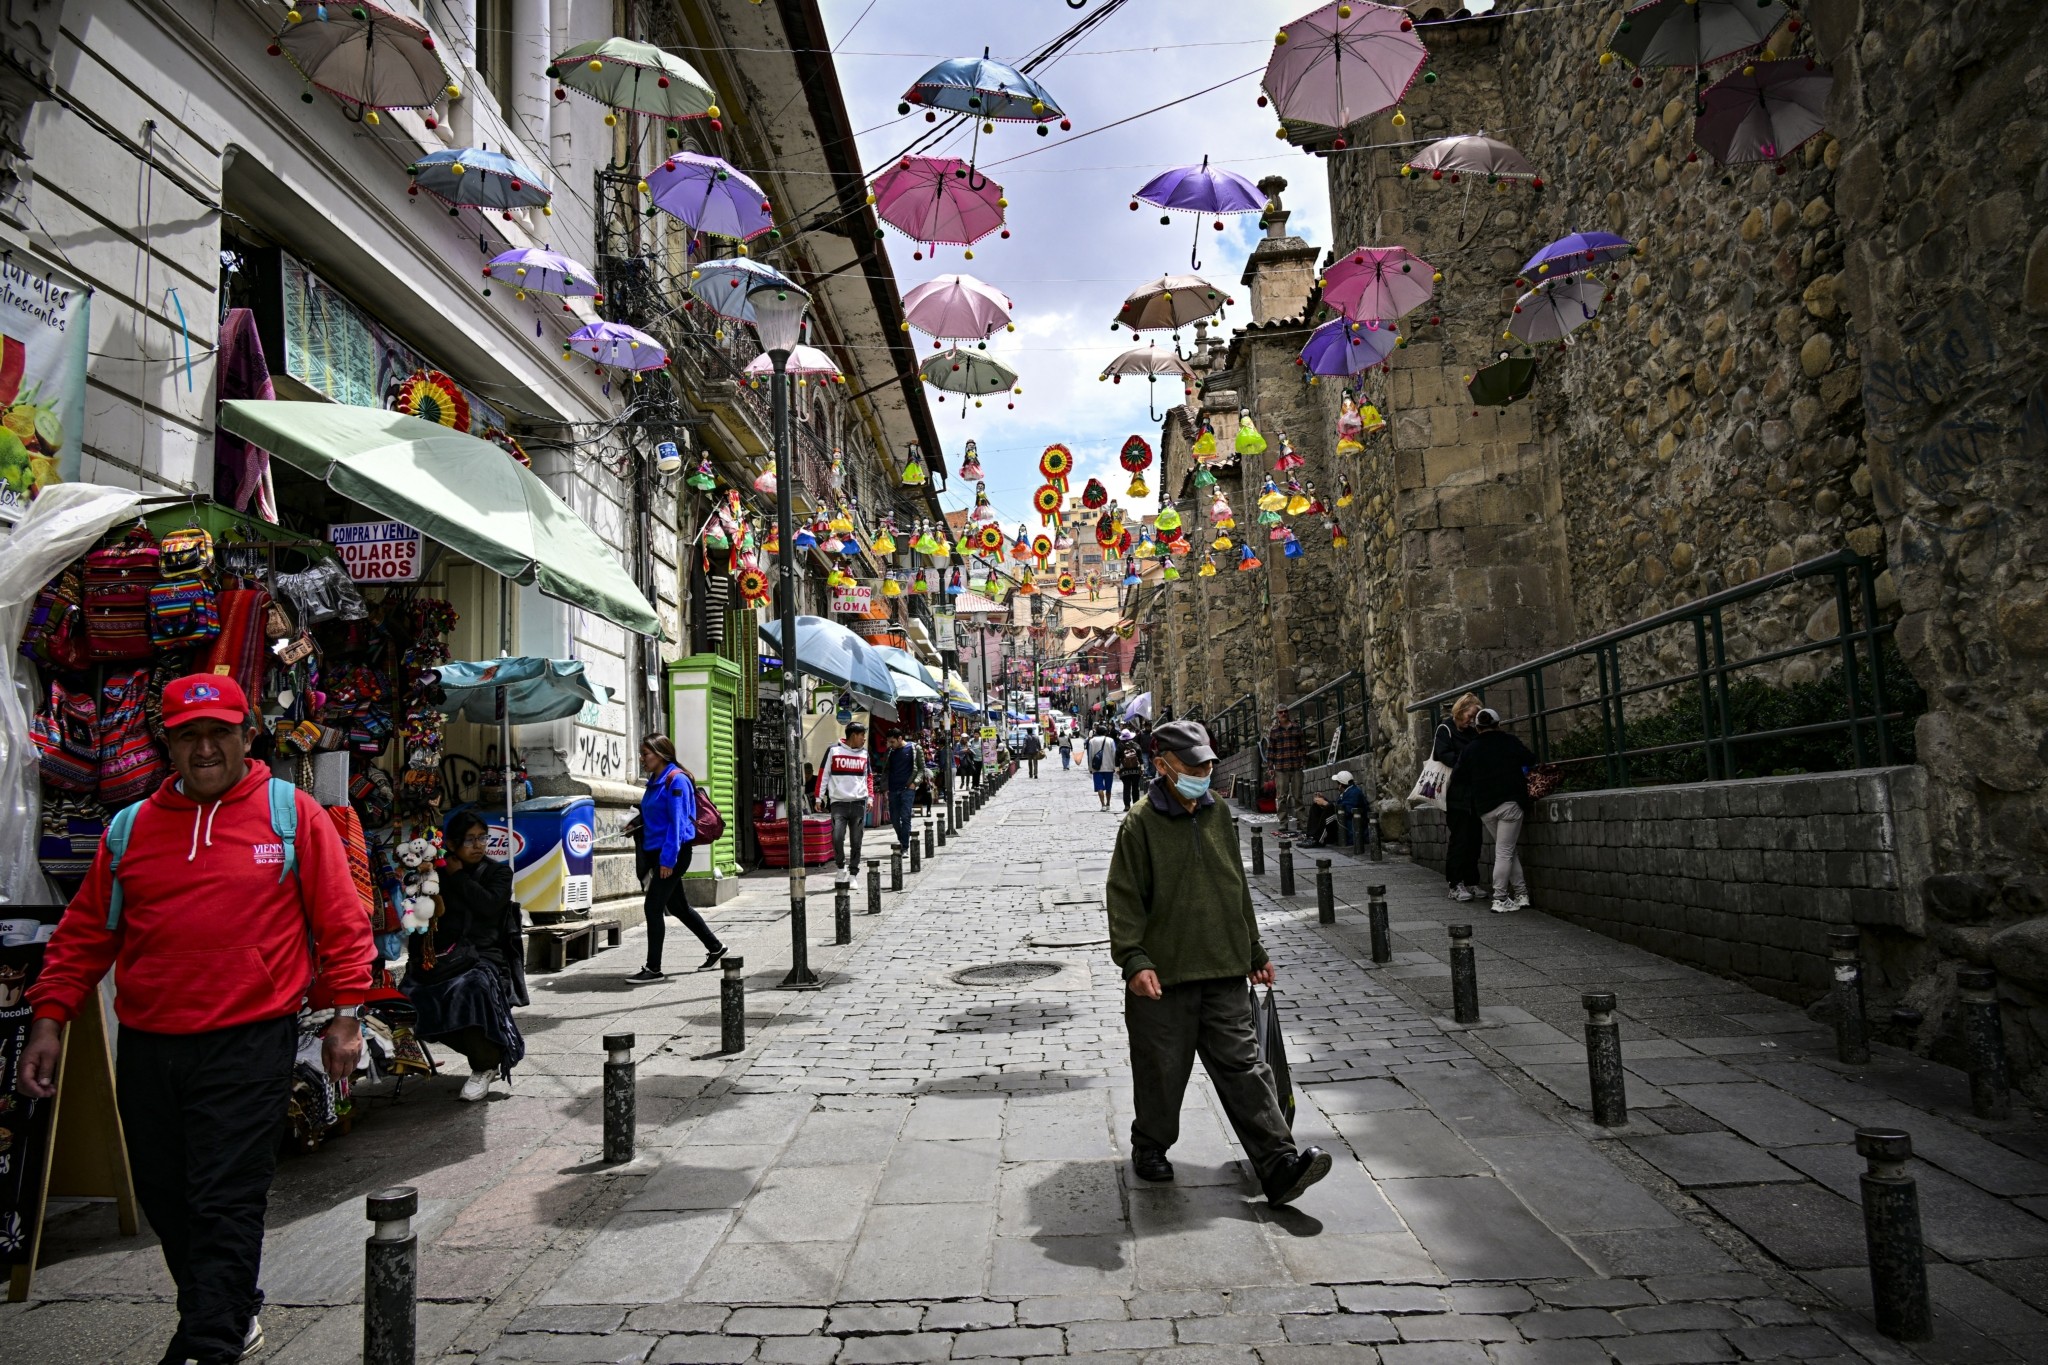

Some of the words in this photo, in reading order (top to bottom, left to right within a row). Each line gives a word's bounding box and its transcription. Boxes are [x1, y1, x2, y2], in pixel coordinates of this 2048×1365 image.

[333, 525, 370, 542] COMPRA
[372, 524, 379, 540] Y
[382, 523, 419, 539] VENTA
[346, 560, 411, 579] UROS
[839, 588, 870, 597] ELLOS
[833, 602, 868, 612] GOMA
[834, 757, 866, 770] TOMMY
[571, 831, 589, 842] Delizia
[253, 843, 284, 854] VIENN
